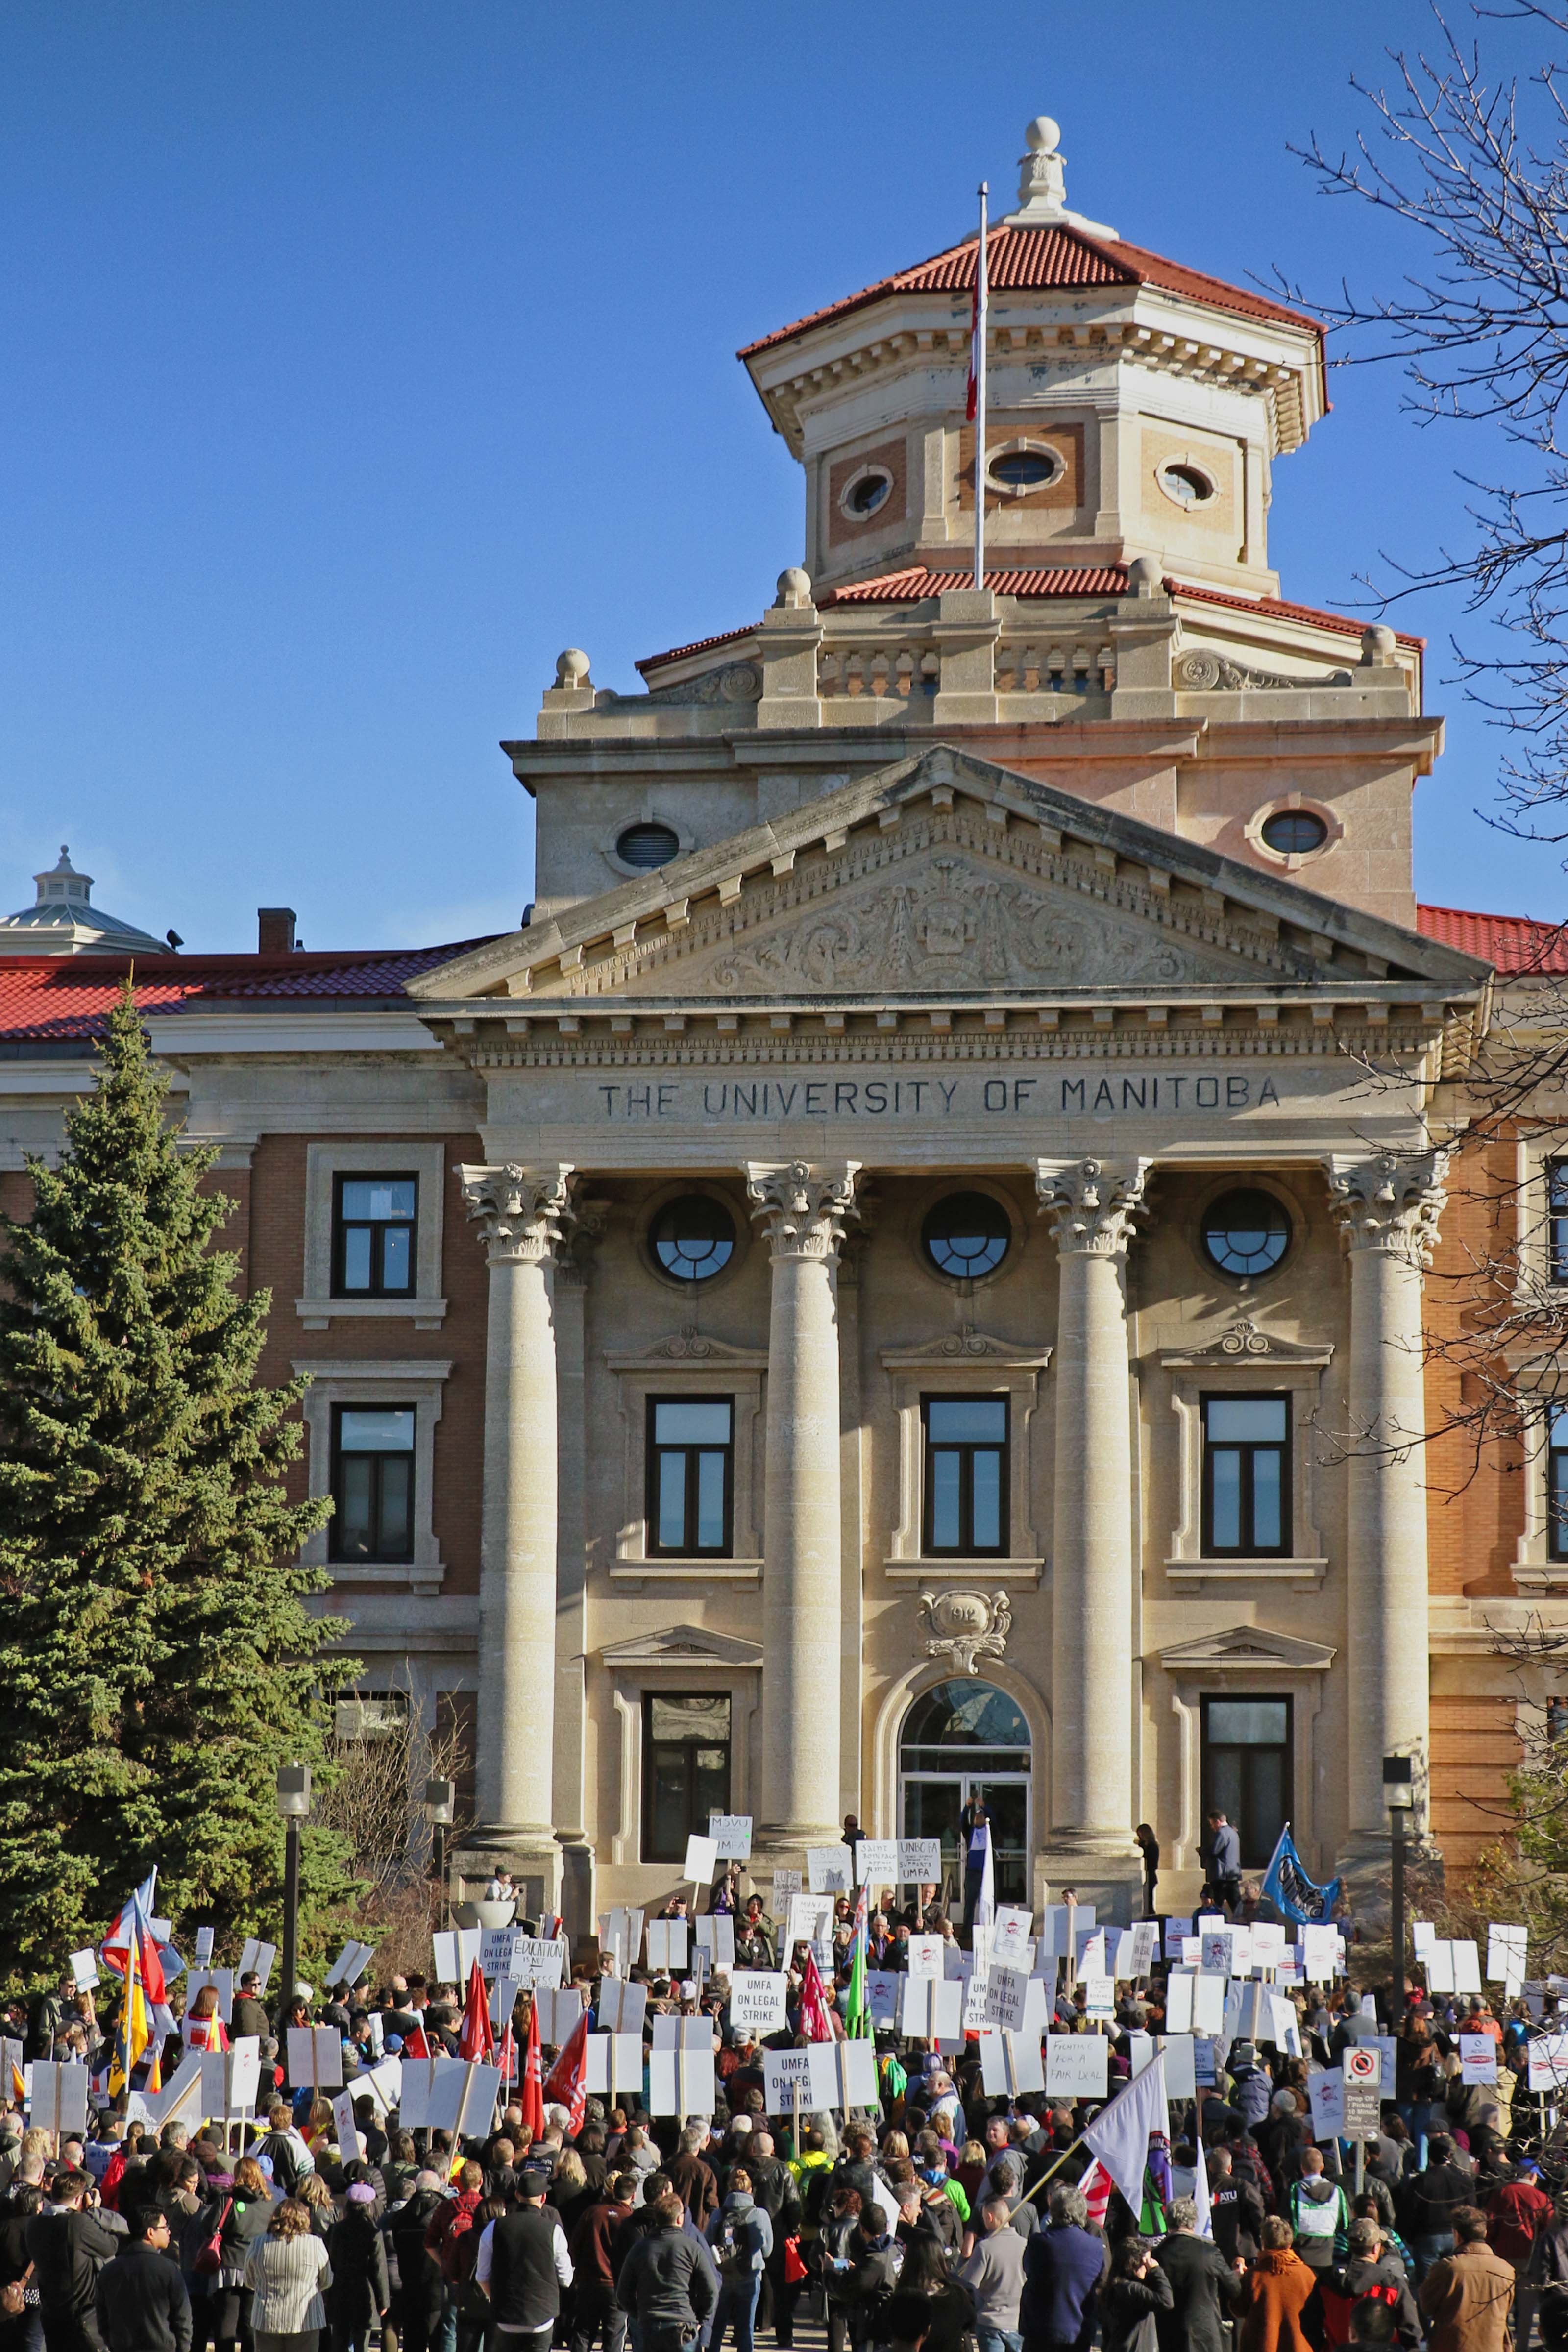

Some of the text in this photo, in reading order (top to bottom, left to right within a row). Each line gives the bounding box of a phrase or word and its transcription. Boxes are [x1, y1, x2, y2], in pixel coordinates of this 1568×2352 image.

[599, 1076, 1280, 1117] THE UNIVERSITY OF MANITOBA
[903, 1868, 930, 1879] UMFA
[492, 1935, 510, 1944] UMFA
[484, 1948, 512, 1958] ON LEGA
[515, 1940, 563, 1958] EDUCATION
[487, 1961, 510, 1971] STRIKE
[748, 1980, 771, 1990] UMFA
[997, 1974, 1015, 1988] UMFA
[974, 1983, 986, 1993] UM
[738, 1995, 780, 2006] ON LEGAL
[989, 1988, 998, 1999] ON
[1000, 1991, 1020, 2007] LEGAL
[743, 2010, 773, 2021] STRIKE
[991, 2005, 1014, 2022] STRIKE
[782, 2058, 809, 2070] UMFA
[1079, 2054, 1086, 2064] A
[1051, 2069, 1072, 2080] FAIR
[772, 2076, 811, 2089] ON LEG
[780, 2093, 813, 2106] STIK
[1220, 2190, 1237, 2202] ATU
